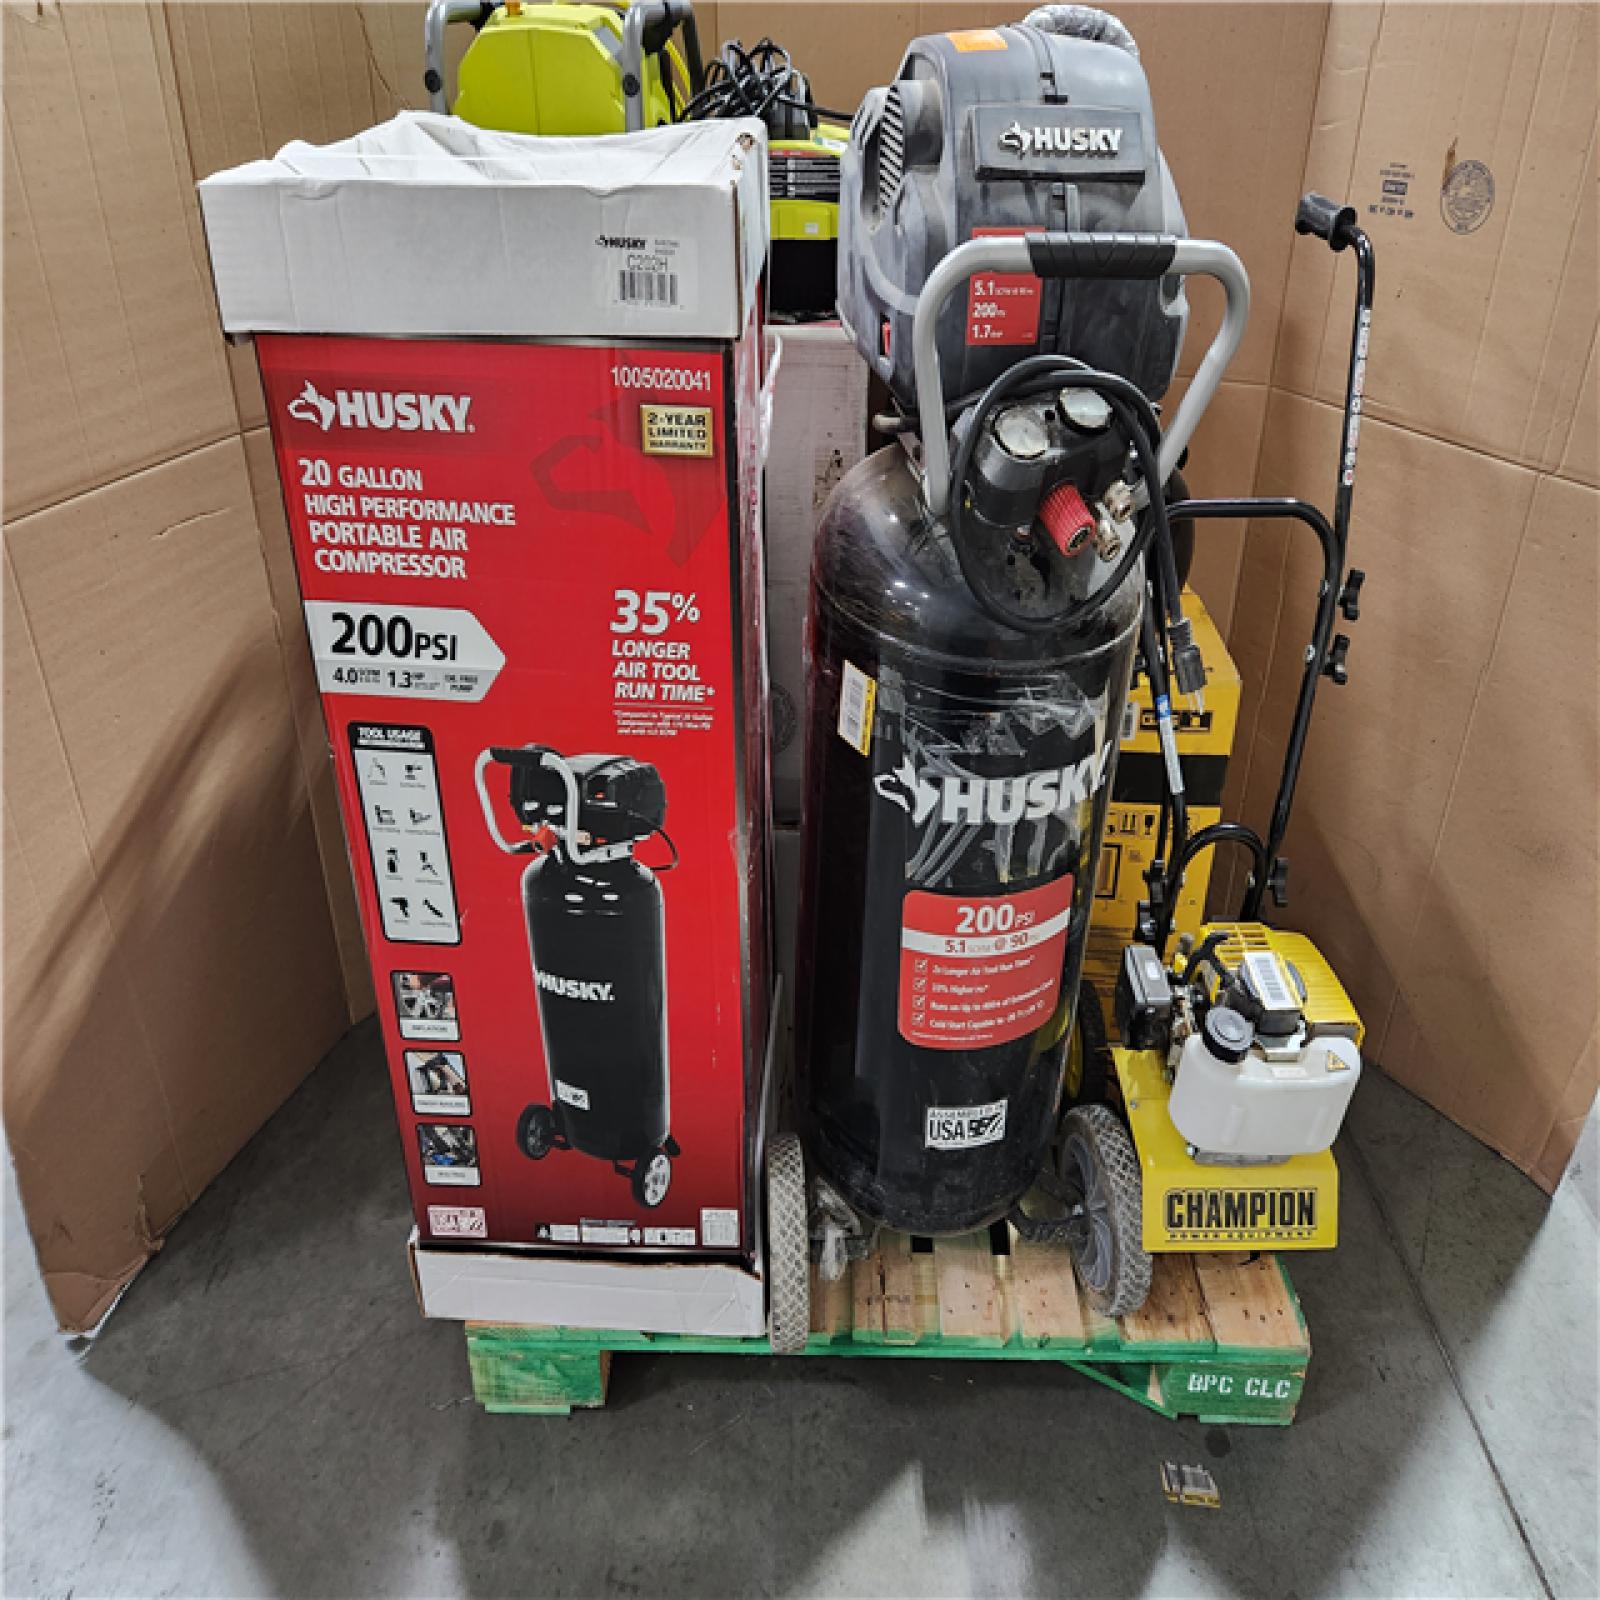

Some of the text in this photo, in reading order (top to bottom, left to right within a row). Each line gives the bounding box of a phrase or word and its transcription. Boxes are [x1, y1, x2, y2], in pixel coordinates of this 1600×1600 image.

[1034, 127, 1123, 152] HUSKY
[609, 235, 647, 251] HUSKY
[974, 279, 995, 296] 5.1
[610, 366, 712, 391] 1005020041
[335, 389, 472, 433] HUSKY
[647, 411, 707, 426] 2-YEAR
[647, 427, 707, 440] LIMITED
[298, 457, 424, 491] 20 GALLON
[304, 494, 517, 526] HIGH PERFORMANCE
[308, 519, 469, 551] PORTABLE AIR
[314, 548, 468, 580] COMPRESSOR
[609, 588, 701, 635] 35%
[611, 639, 691, 660] LONGER
[332, 667, 359, 684] 4.0
[387, 670, 412, 689] 1.3
[613, 660, 701, 681] AIR TOOL
[614, 681, 656, 699] RUN
[357, 726, 422, 741] TOOL USAGE
[944, 939, 967, 953] 5.1
[1009, 932, 1029, 949] 90
[535, 969, 614, 1001] HUSKY
[929, 1119, 966, 1141] USA
[1166, 1190, 1315, 1229] CHAMPION
[1244, 1377, 1291, 1399] CLC
